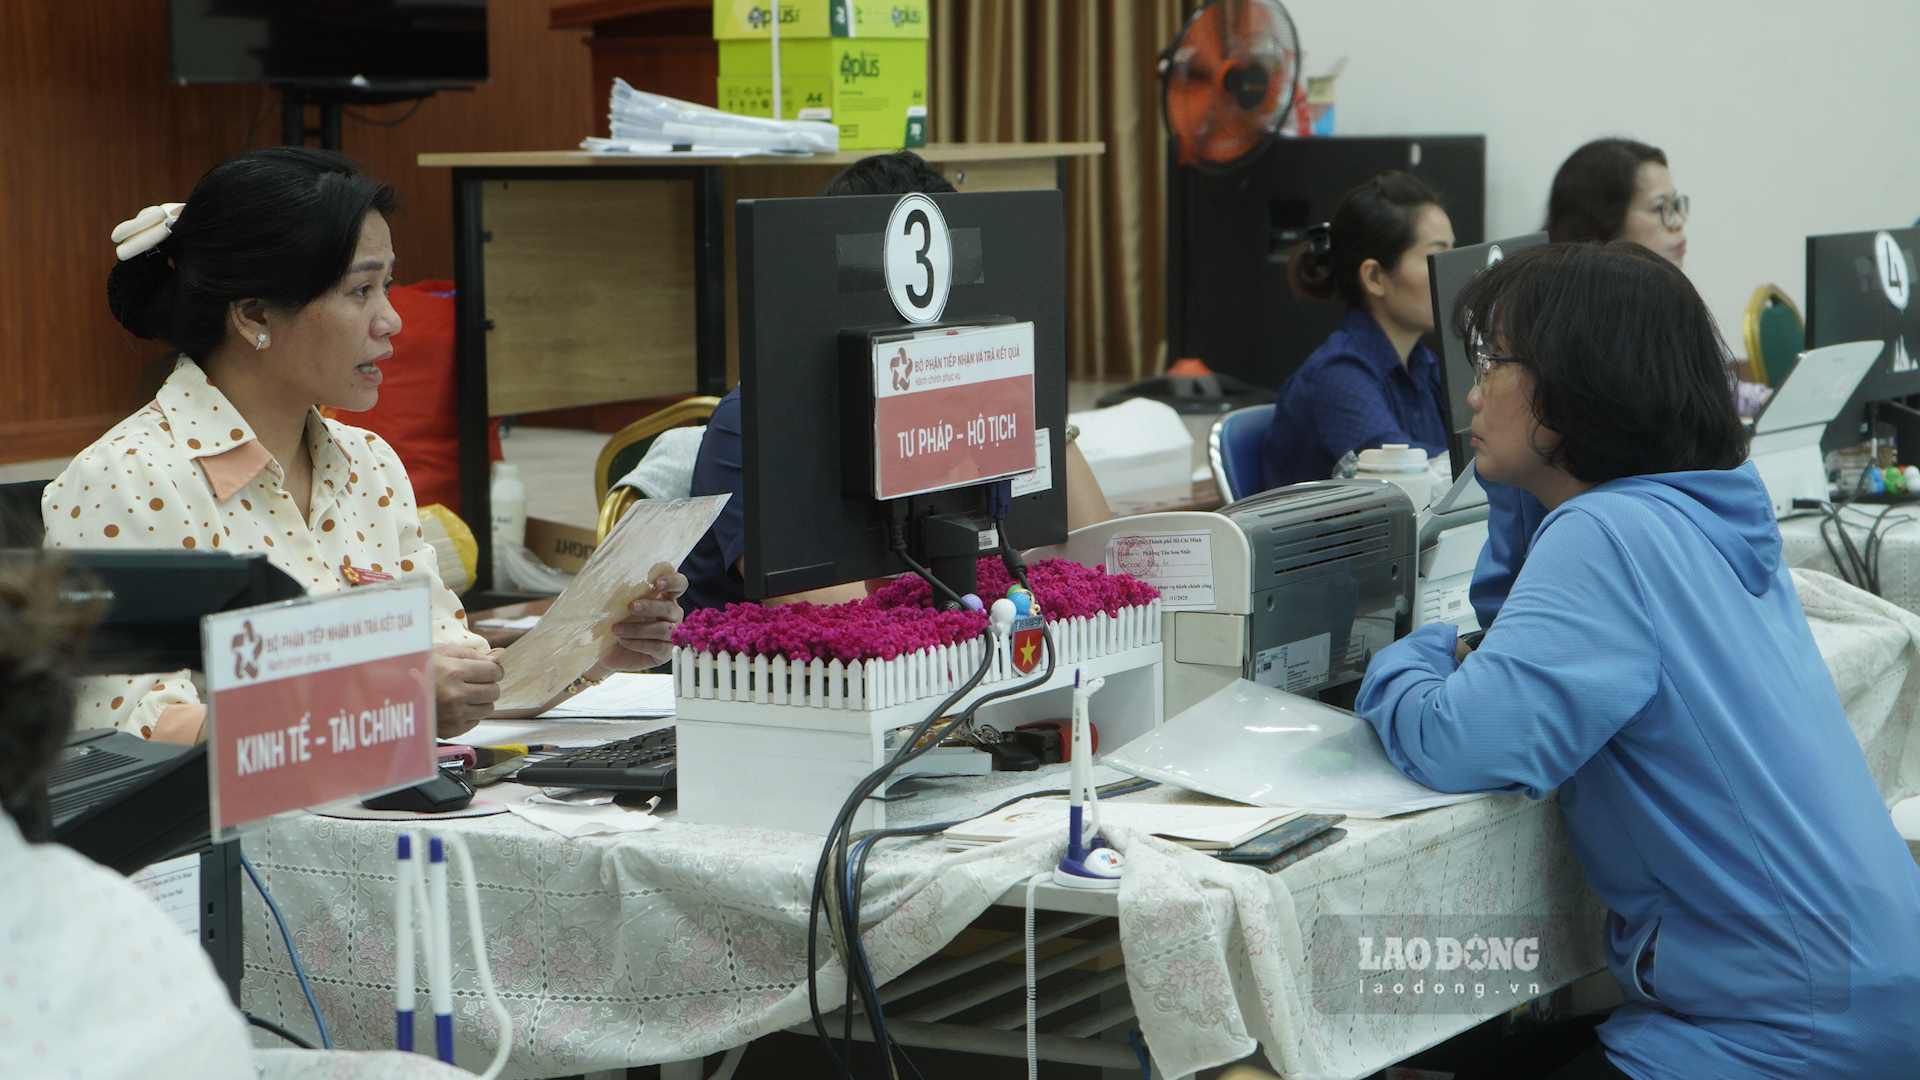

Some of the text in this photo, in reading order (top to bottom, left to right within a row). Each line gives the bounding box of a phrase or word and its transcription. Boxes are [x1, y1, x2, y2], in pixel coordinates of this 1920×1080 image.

[904, 209, 934, 308] 3
[1886, 240, 1903, 296] 4
[897, 428, 915, 459] TƯ
[919, 420, 953, 454] PHÁP
[967, 412, 985, 451] HỘ
[988, 413, 1016, 448] TỊCH
[236, 731, 286, 776] KINH
[288, 711, 312, 764] TẾ
[328, 708, 356, 754] TÀI
[360, 698, 416, 748] CHÍNH
